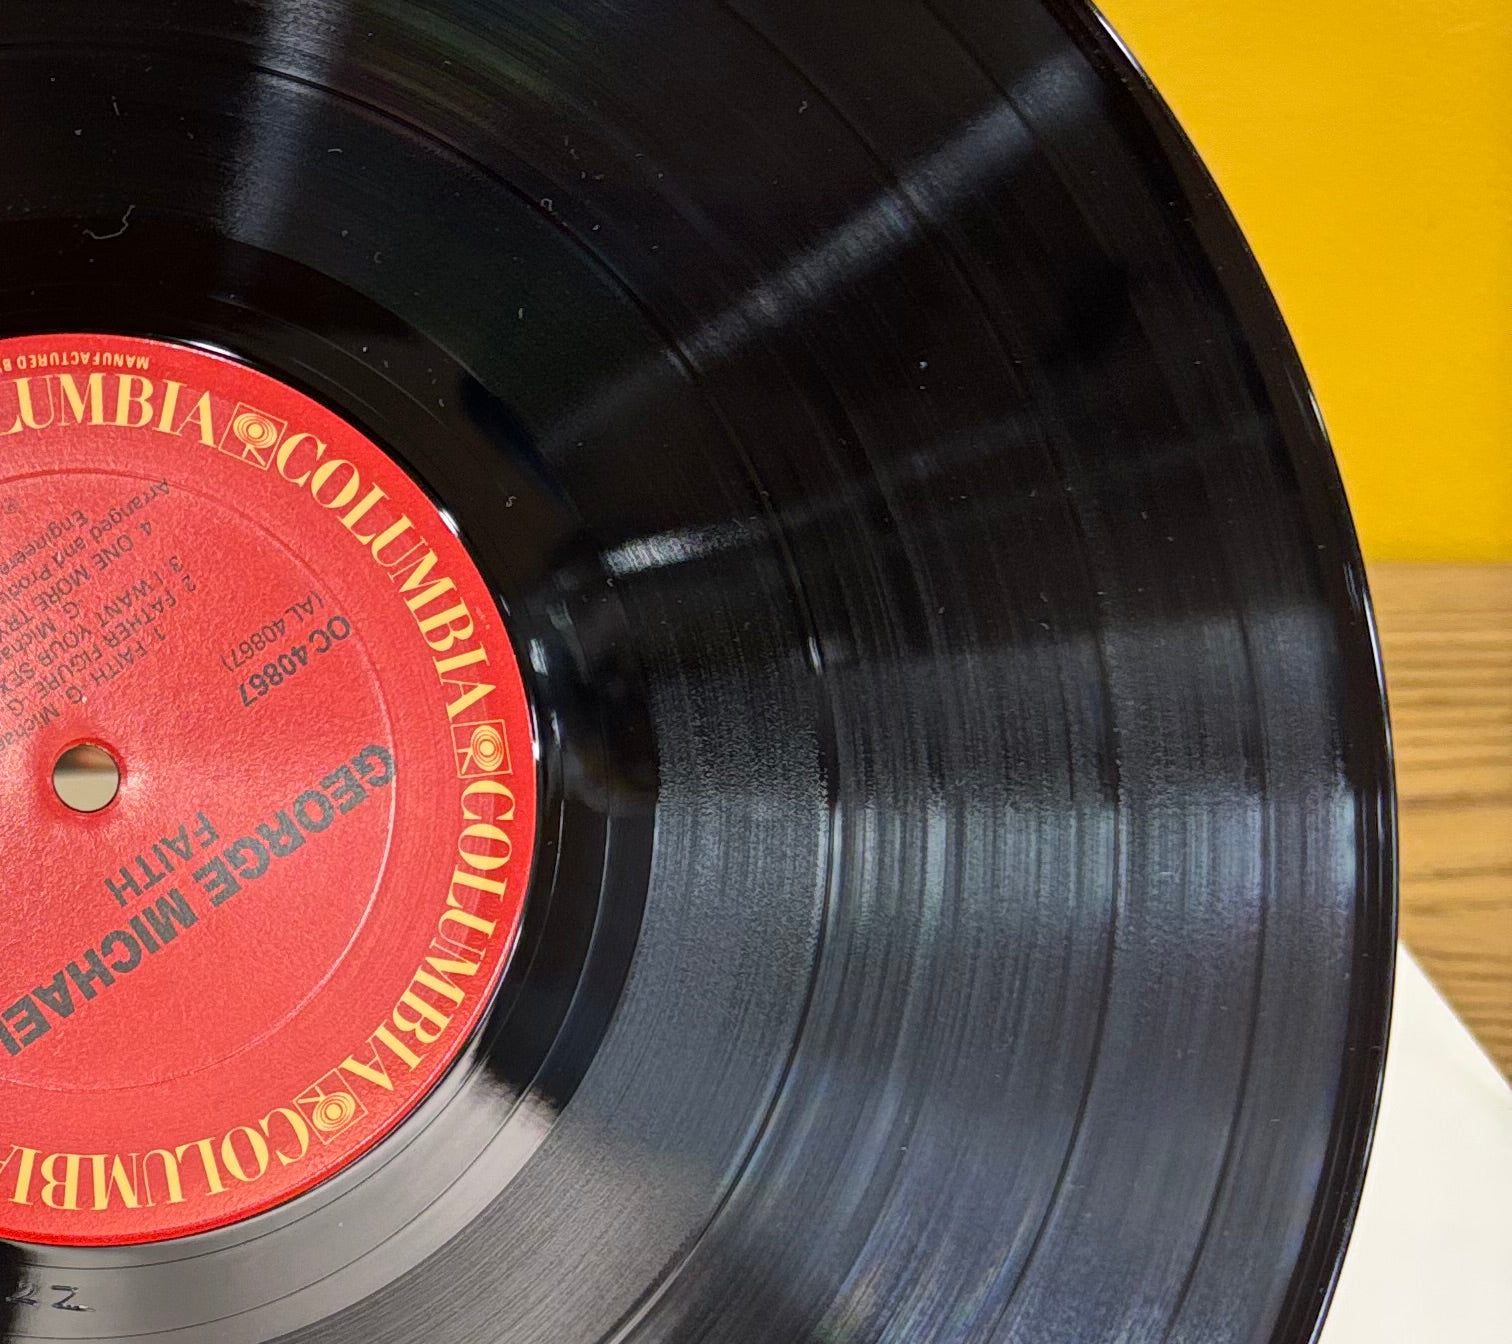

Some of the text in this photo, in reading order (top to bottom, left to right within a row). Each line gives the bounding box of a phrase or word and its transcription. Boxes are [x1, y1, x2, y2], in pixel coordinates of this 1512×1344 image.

[16, 352, 150, 373] MANUFACTURED
[84, 473, 173, 545] Arranged
[49, 535, 89, 570] and
[90, 531, 135, 571] ONE
[274, 422, 495, 720] COLUMBIA
[31, 563, 92, 613] MORE
[92, 577, 153, 627] WANT
[29, 588, 178, 701] FATHER FIGURE
[34, 619, 93, 669] YOUR
[89, 639, 148, 689] FAITH
[217, 612, 291, 674] 40867)
[232, 611, 354, 708] OC 40867
[190, 737, 403, 909] GEORGE
[102, 809, 221, 908] FAITH
[339, 767, 513, 1092] COLUMBIA
